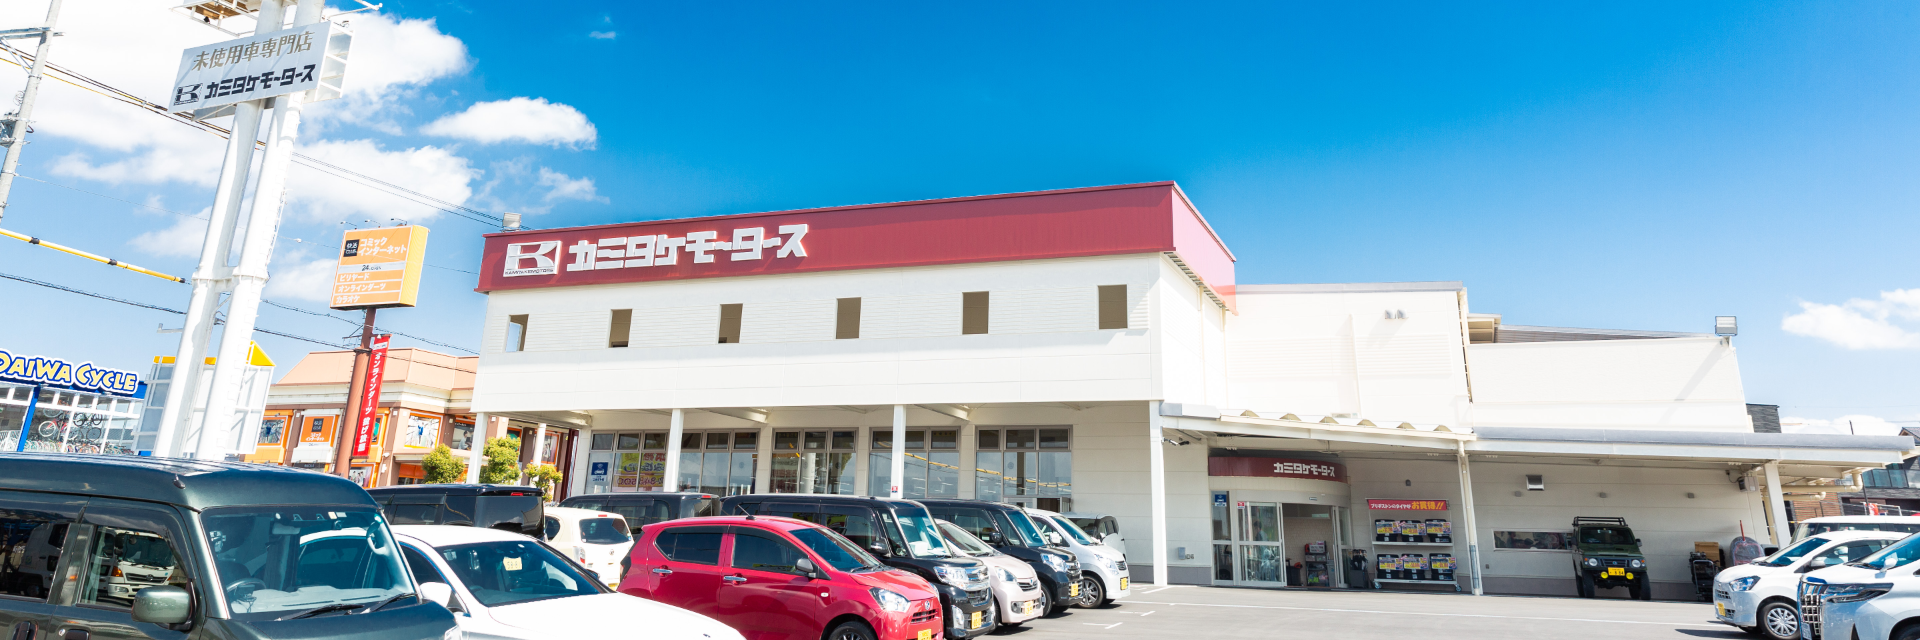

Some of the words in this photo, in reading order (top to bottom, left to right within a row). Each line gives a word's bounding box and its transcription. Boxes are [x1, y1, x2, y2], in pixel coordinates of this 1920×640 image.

[192, 30, 316, 72] 未使用車専門店
[204, 64, 317, 100] カミタケモータース
[360, 236, 388, 247] コミック
[566, 223, 809, 272] カミタケモータース
[359, 244, 407, 256] インターネット
[339, 273, 370, 282] ビリヤード
[337, 283, 387, 293] オンラインダーツ
[335, 295, 360, 304] カラオケ
[0, 350, 72, 385] DAIWA
[75, 362, 138, 392] CYCLE
[1273, 462, 1336, 477] カミタケモータース
